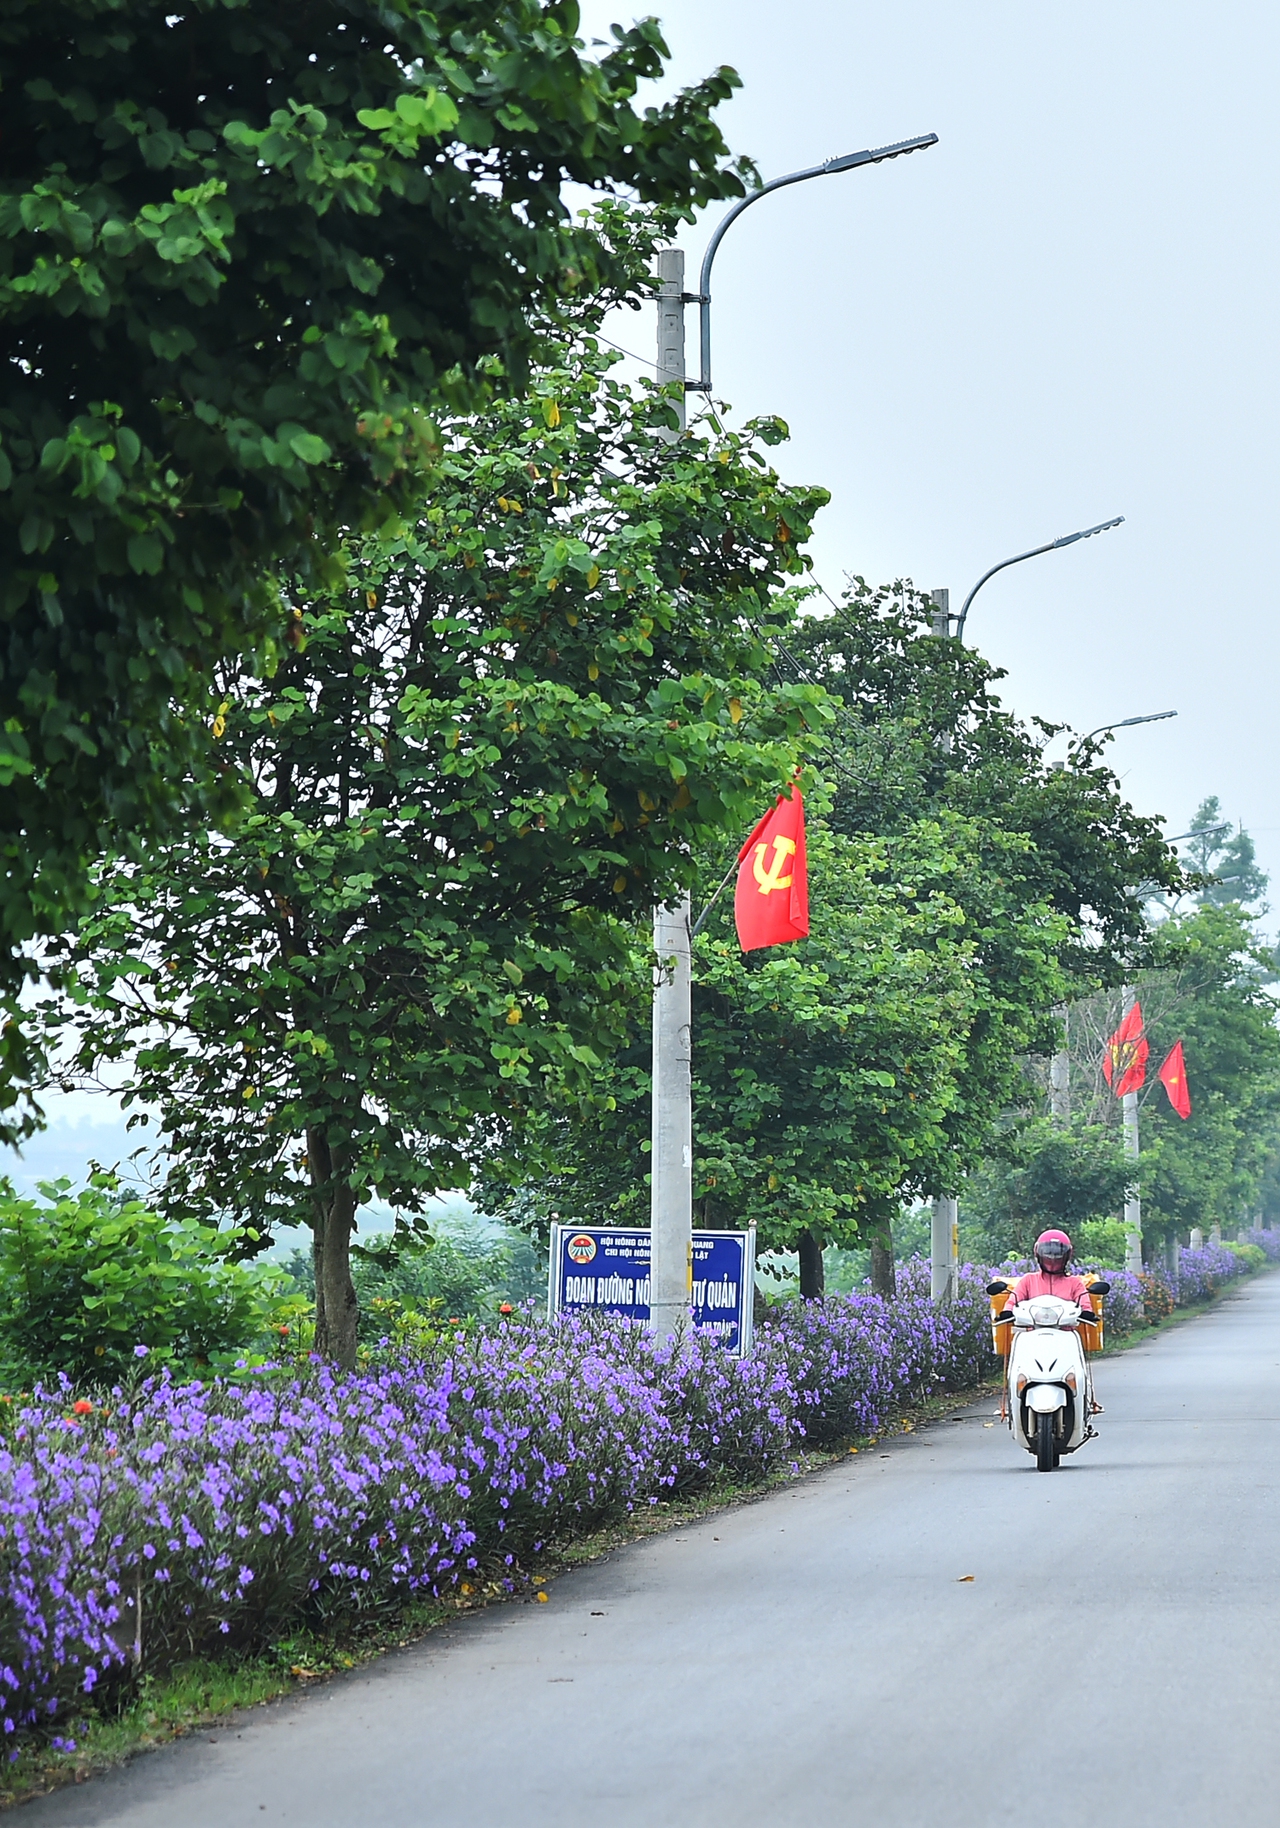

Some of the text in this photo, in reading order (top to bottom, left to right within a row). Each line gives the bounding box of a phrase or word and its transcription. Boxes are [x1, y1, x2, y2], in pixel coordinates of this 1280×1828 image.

[600, 1236, 614, 1247] HỘI
[614, 1236, 636, 1247] NÔNG
[692, 1240, 714, 1249] UANG
[604, 1248, 618, 1256] CHI
[619, 1247, 633, 1258] HỘI
[633, 1248, 651, 1258] NÔN
[597, 1271, 634, 1305] ĐƯỜNG
[707, 1272, 737, 1311] QUẢN
